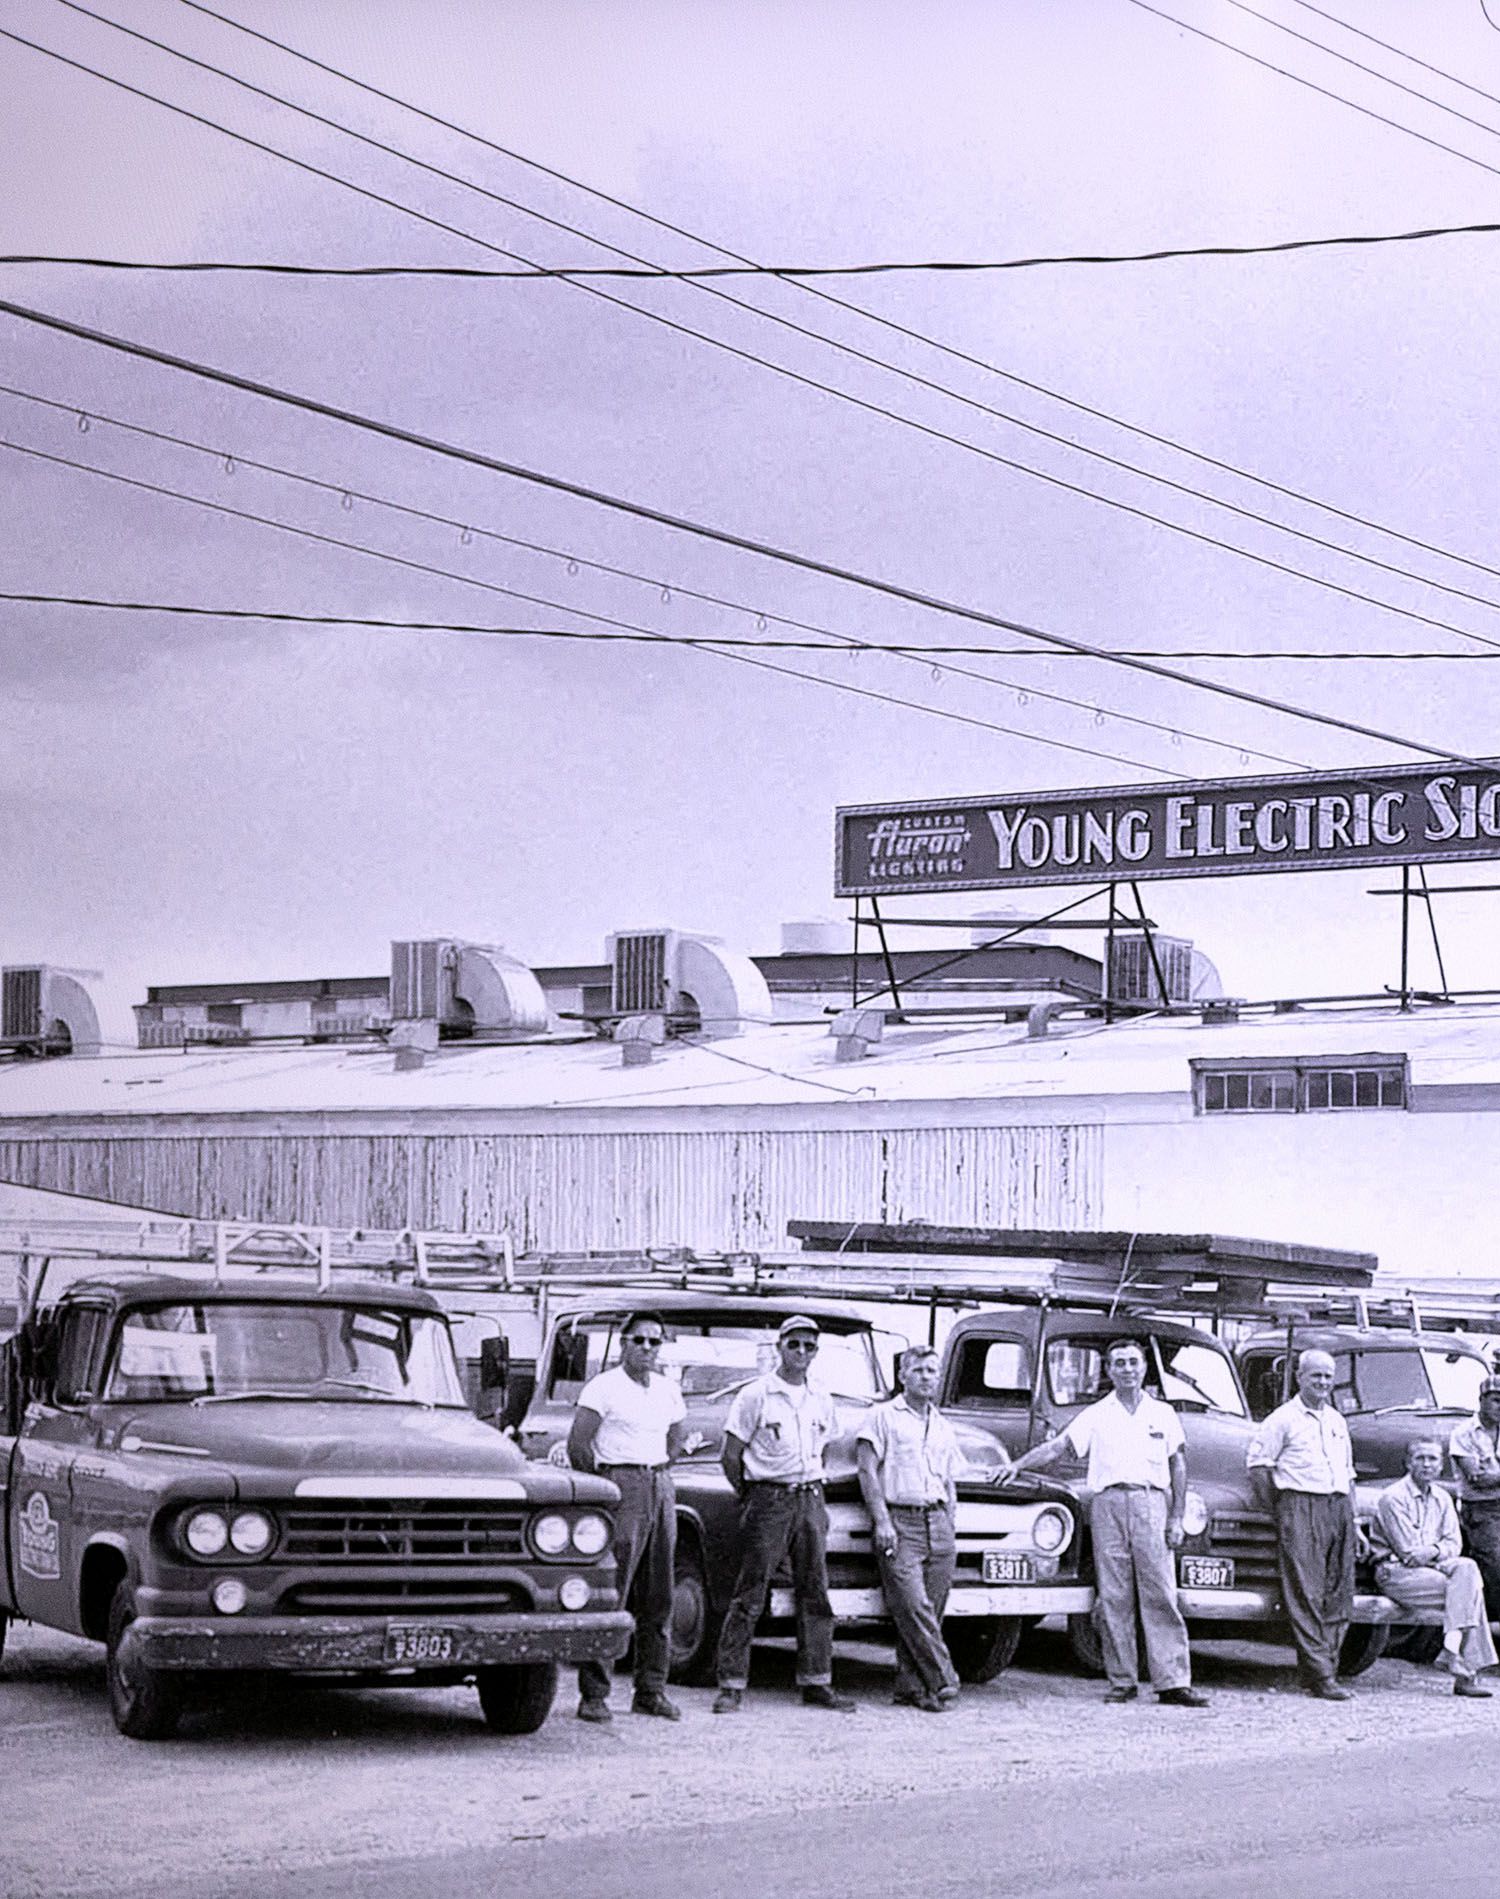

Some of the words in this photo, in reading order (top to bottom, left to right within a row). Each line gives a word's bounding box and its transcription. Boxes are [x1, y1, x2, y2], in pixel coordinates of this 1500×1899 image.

[986, 806, 1150, 869] YOUNG
[1164, 791, 1406, 859] ELECTRIC
[869, 858, 963, 878] LIGHTING
